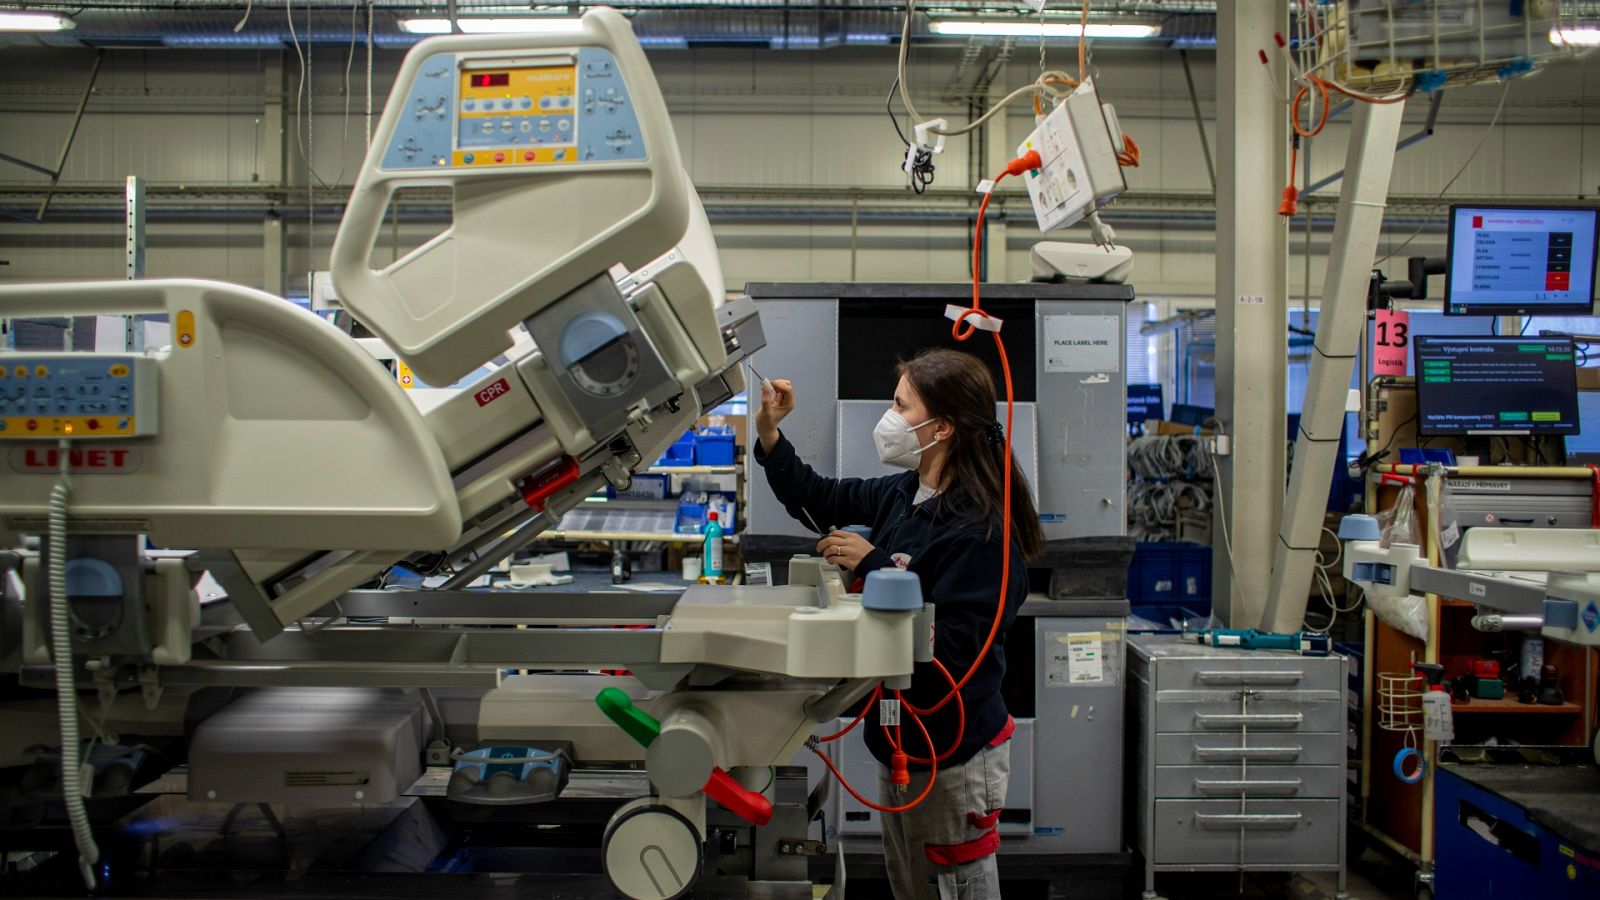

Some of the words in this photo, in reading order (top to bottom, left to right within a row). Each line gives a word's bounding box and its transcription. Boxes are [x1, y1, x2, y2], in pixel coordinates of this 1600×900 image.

[1376, 321, 1408, 348] 13
[1378, 358, 1403, 367] Logistik
[480, 383, 505, 402] CPR
[25, 449, 128, 467] LINET
